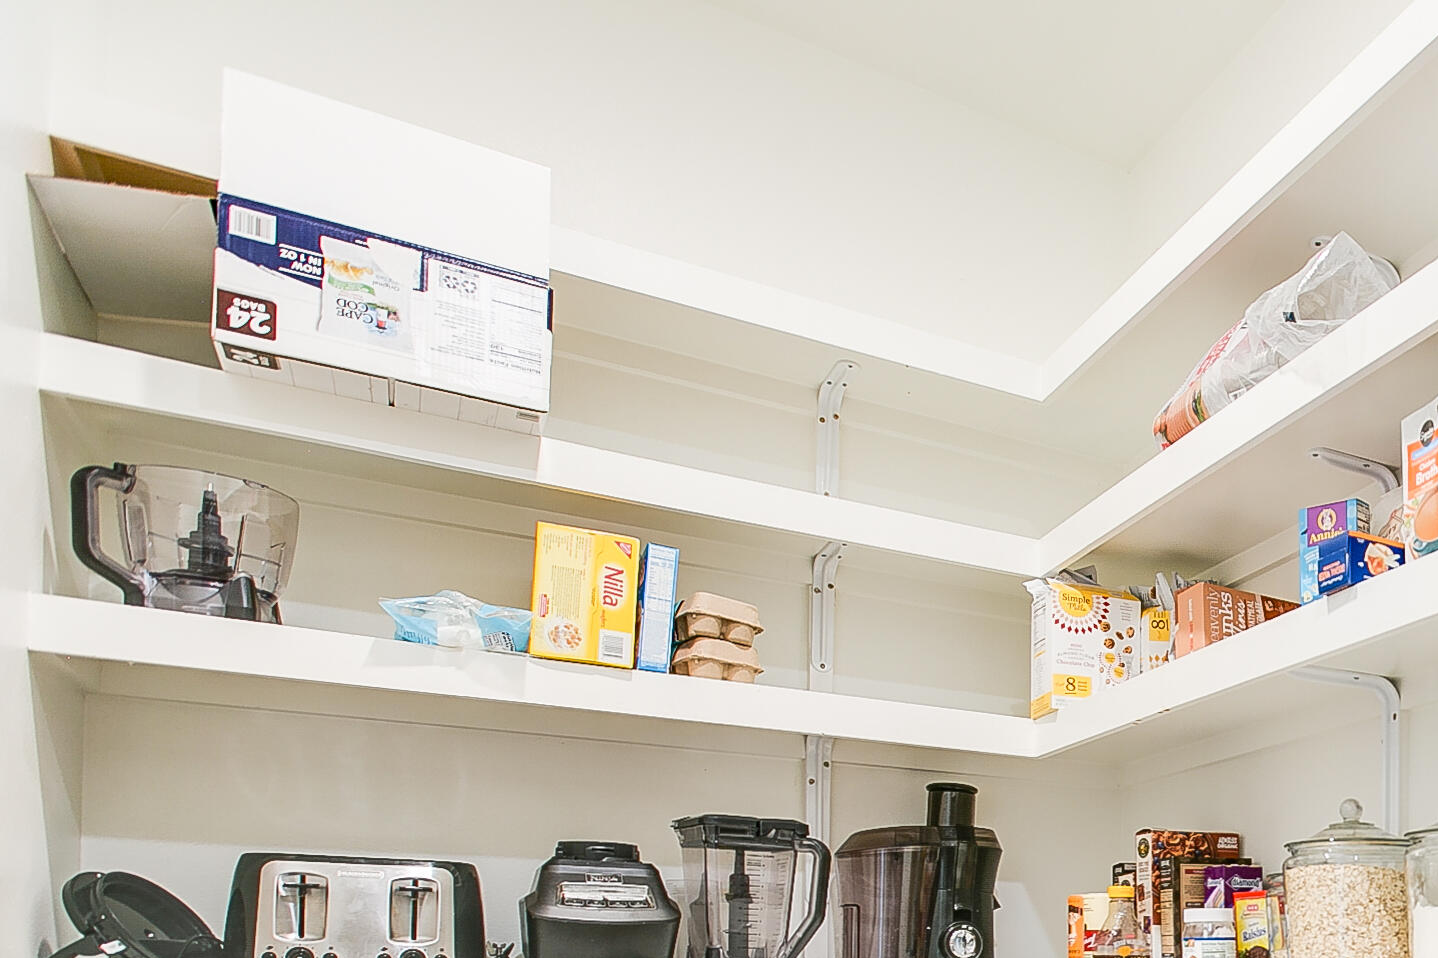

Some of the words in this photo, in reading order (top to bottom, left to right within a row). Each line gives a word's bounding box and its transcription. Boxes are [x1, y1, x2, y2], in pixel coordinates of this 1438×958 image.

[291, 260, 322, 276] NOW
[232, 297, 266, 312] BAGS
[336, 298, 369, 314] COD
[226, 305, 272, 335] 24
[336, 307, 374, 325] CAPE
[602, 565, 625, 608] Nilla
[1062, 593, 1091, 605] Simple
[1207, 586, 1221, 642] eavenly
[1219, 591, 1235, 638] unks
[1065, 677, 1076, 691] 8
[1232, 877, 1260, 888] diamond
